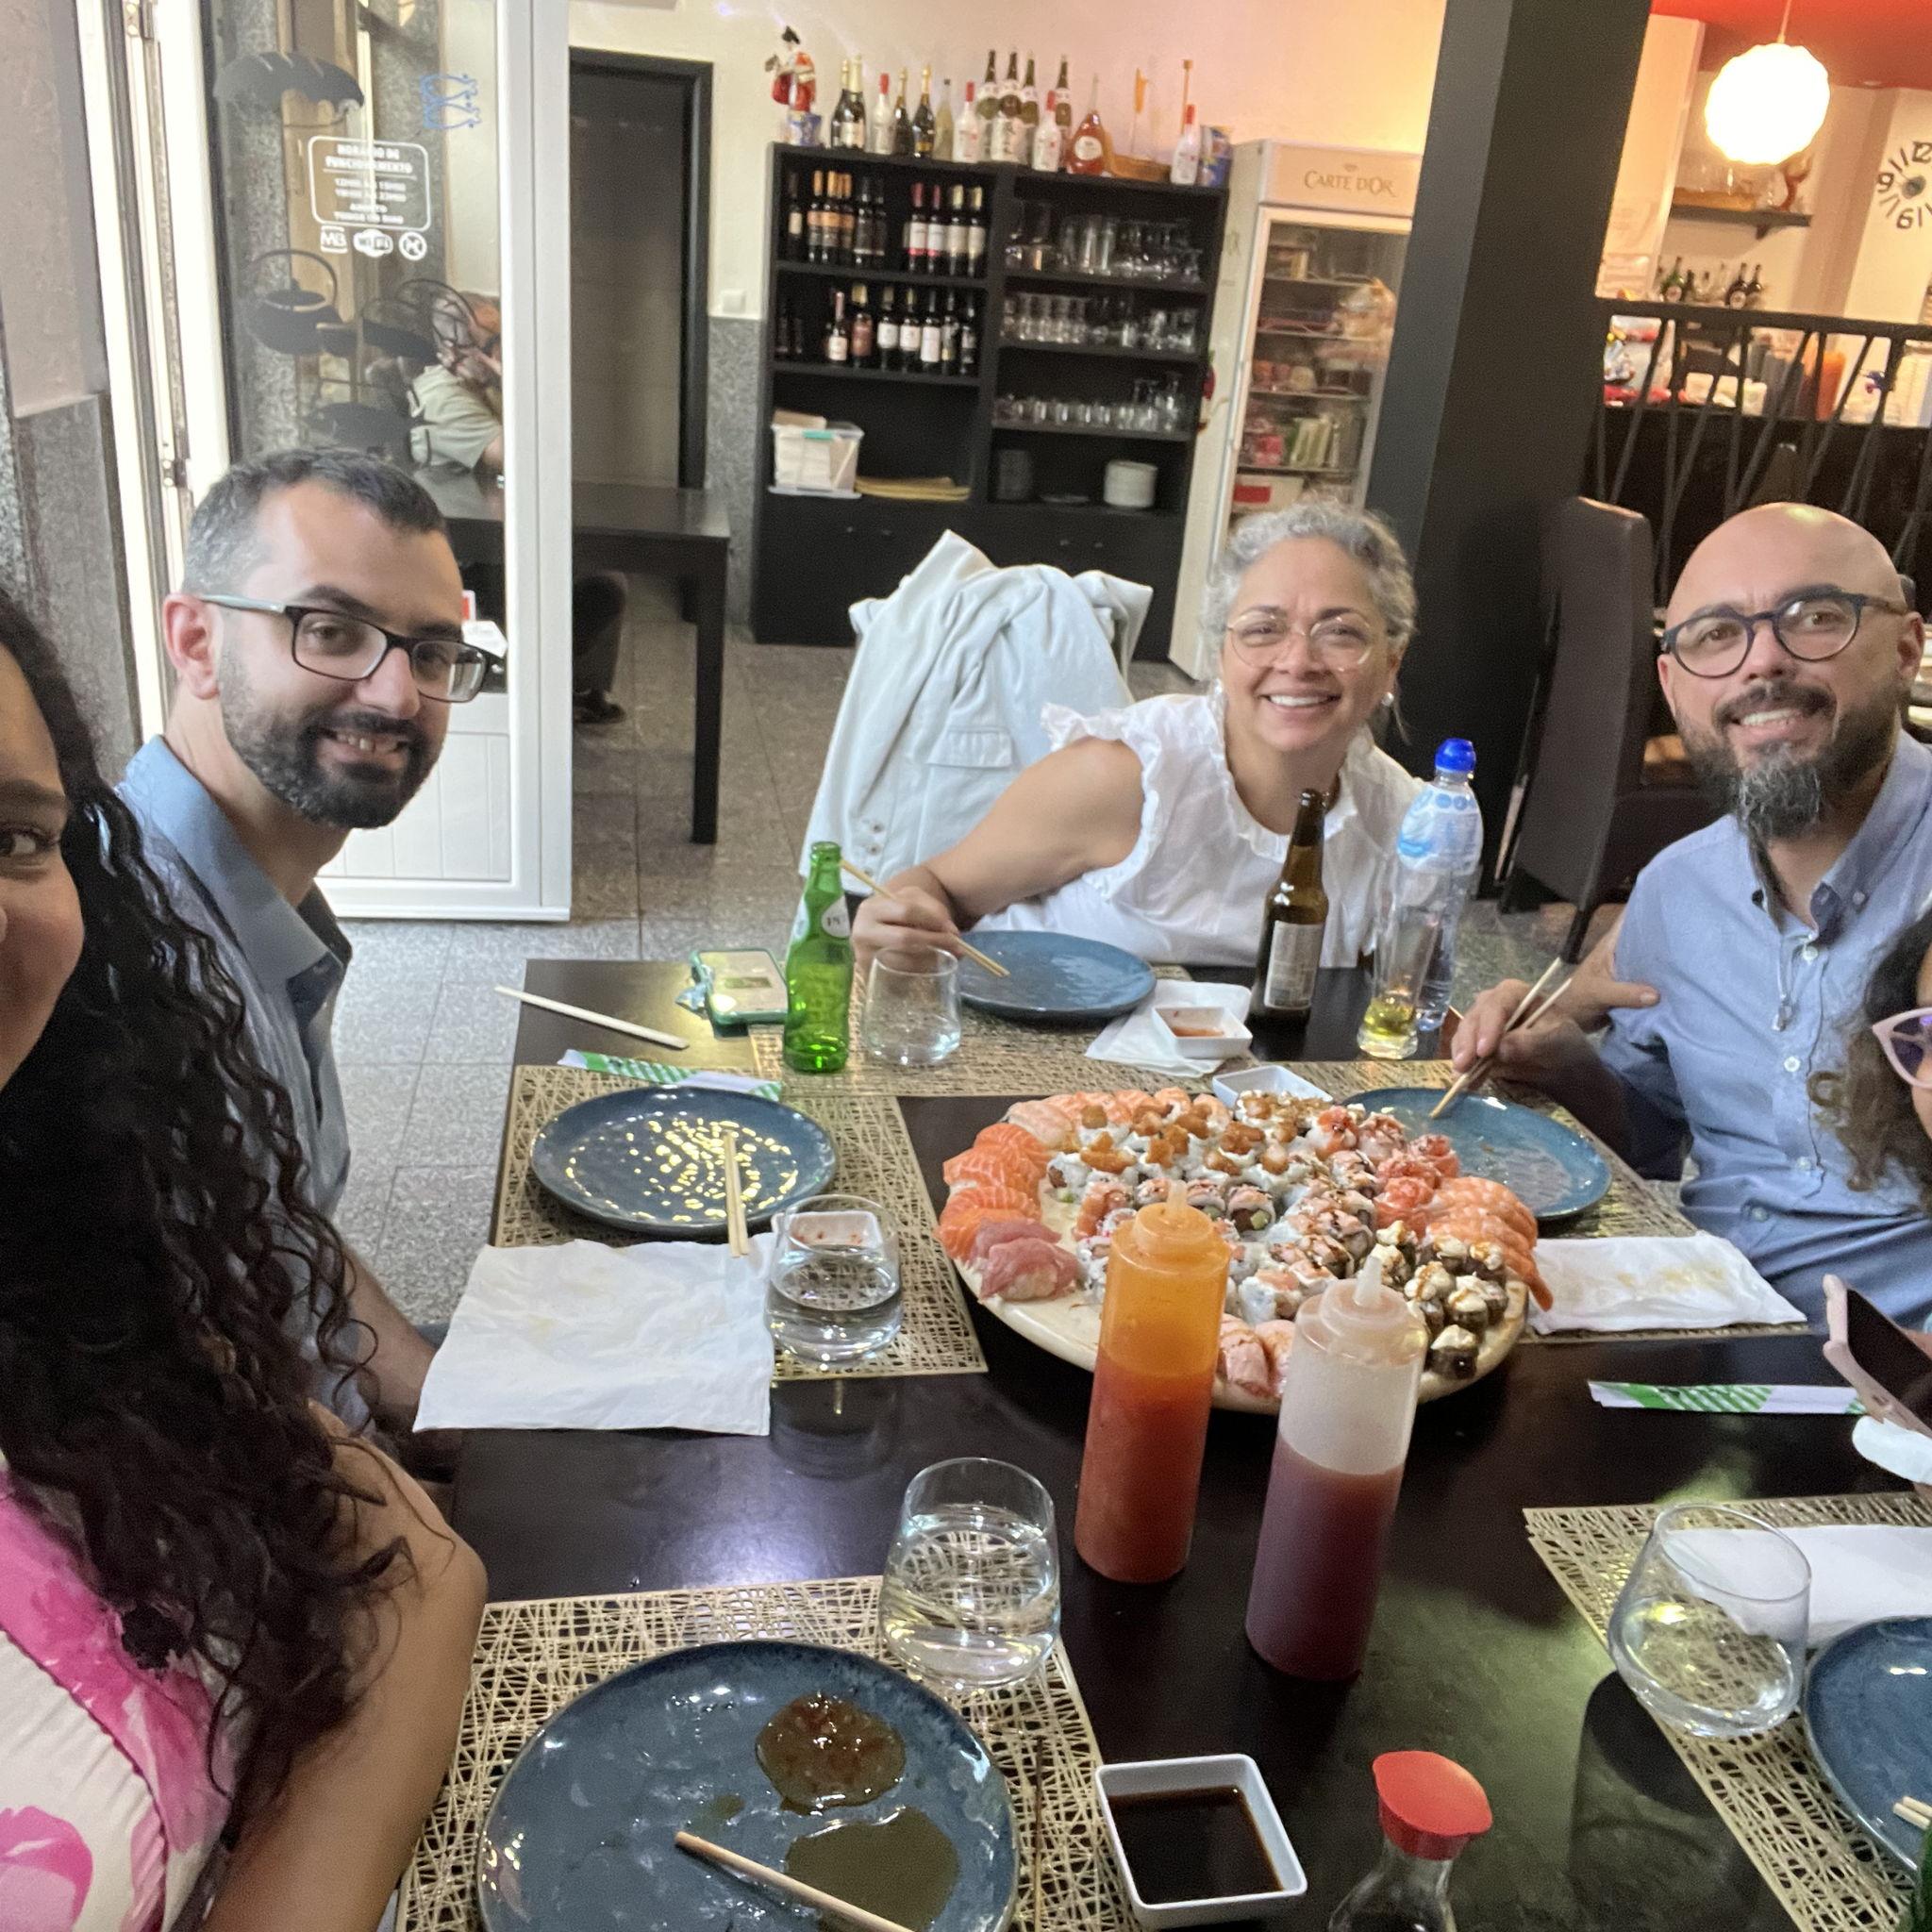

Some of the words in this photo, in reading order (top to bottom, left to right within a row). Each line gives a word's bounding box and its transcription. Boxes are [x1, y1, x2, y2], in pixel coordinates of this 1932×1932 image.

[1304, 170, 1353, 191] CARTE
[1877, 172, 1894, 193] 9
[1896, 208, 1914, 229] 6
